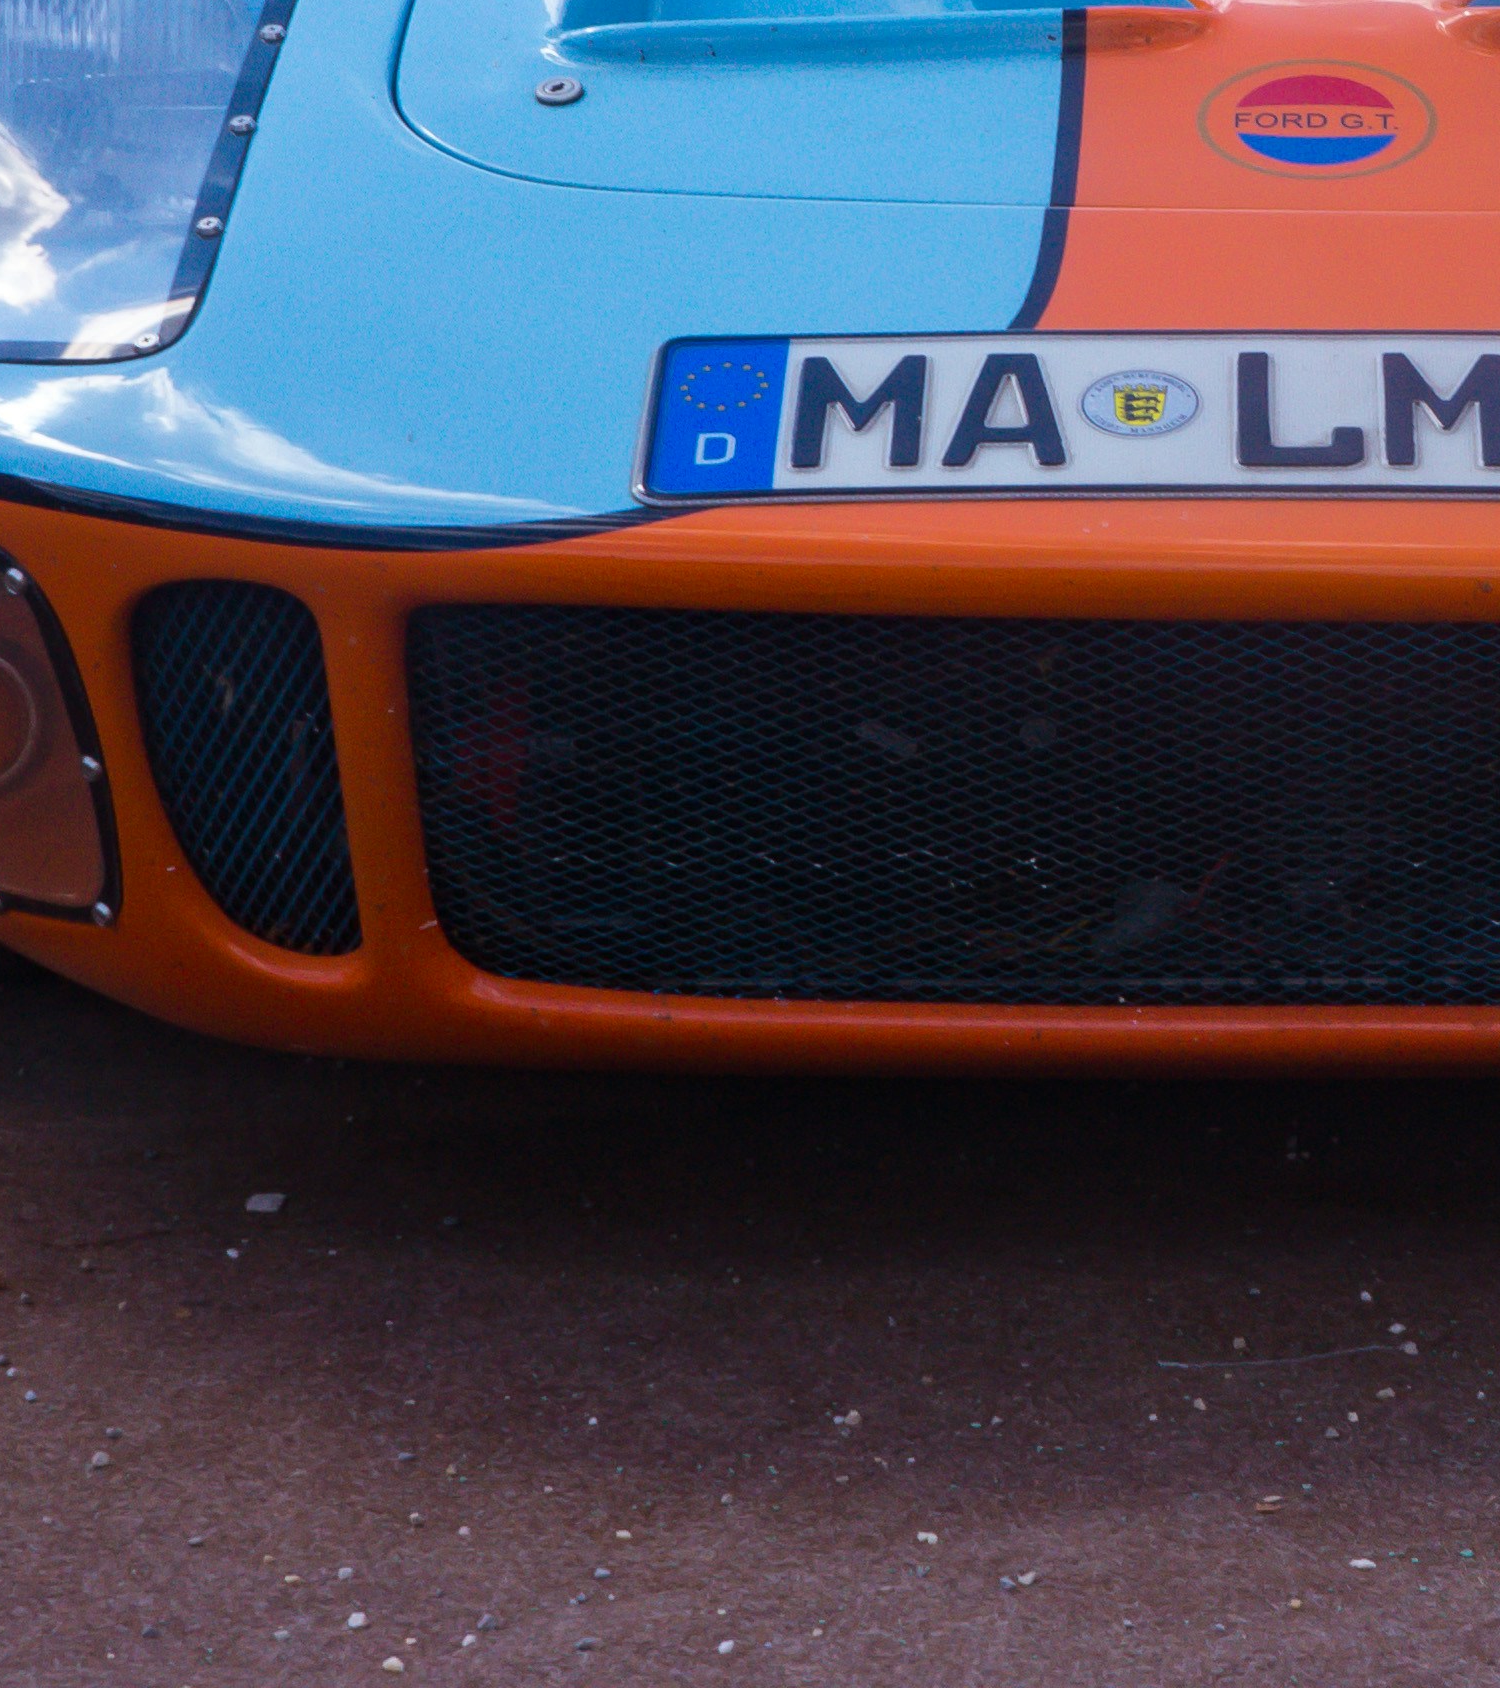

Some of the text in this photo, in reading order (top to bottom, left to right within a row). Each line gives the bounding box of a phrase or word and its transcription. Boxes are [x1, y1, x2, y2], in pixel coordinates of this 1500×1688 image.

[1233, 111, 1400, 132] FORD G.T.
[790, 353, 1068, 469] MA
[694, 432, 736, 466] D
